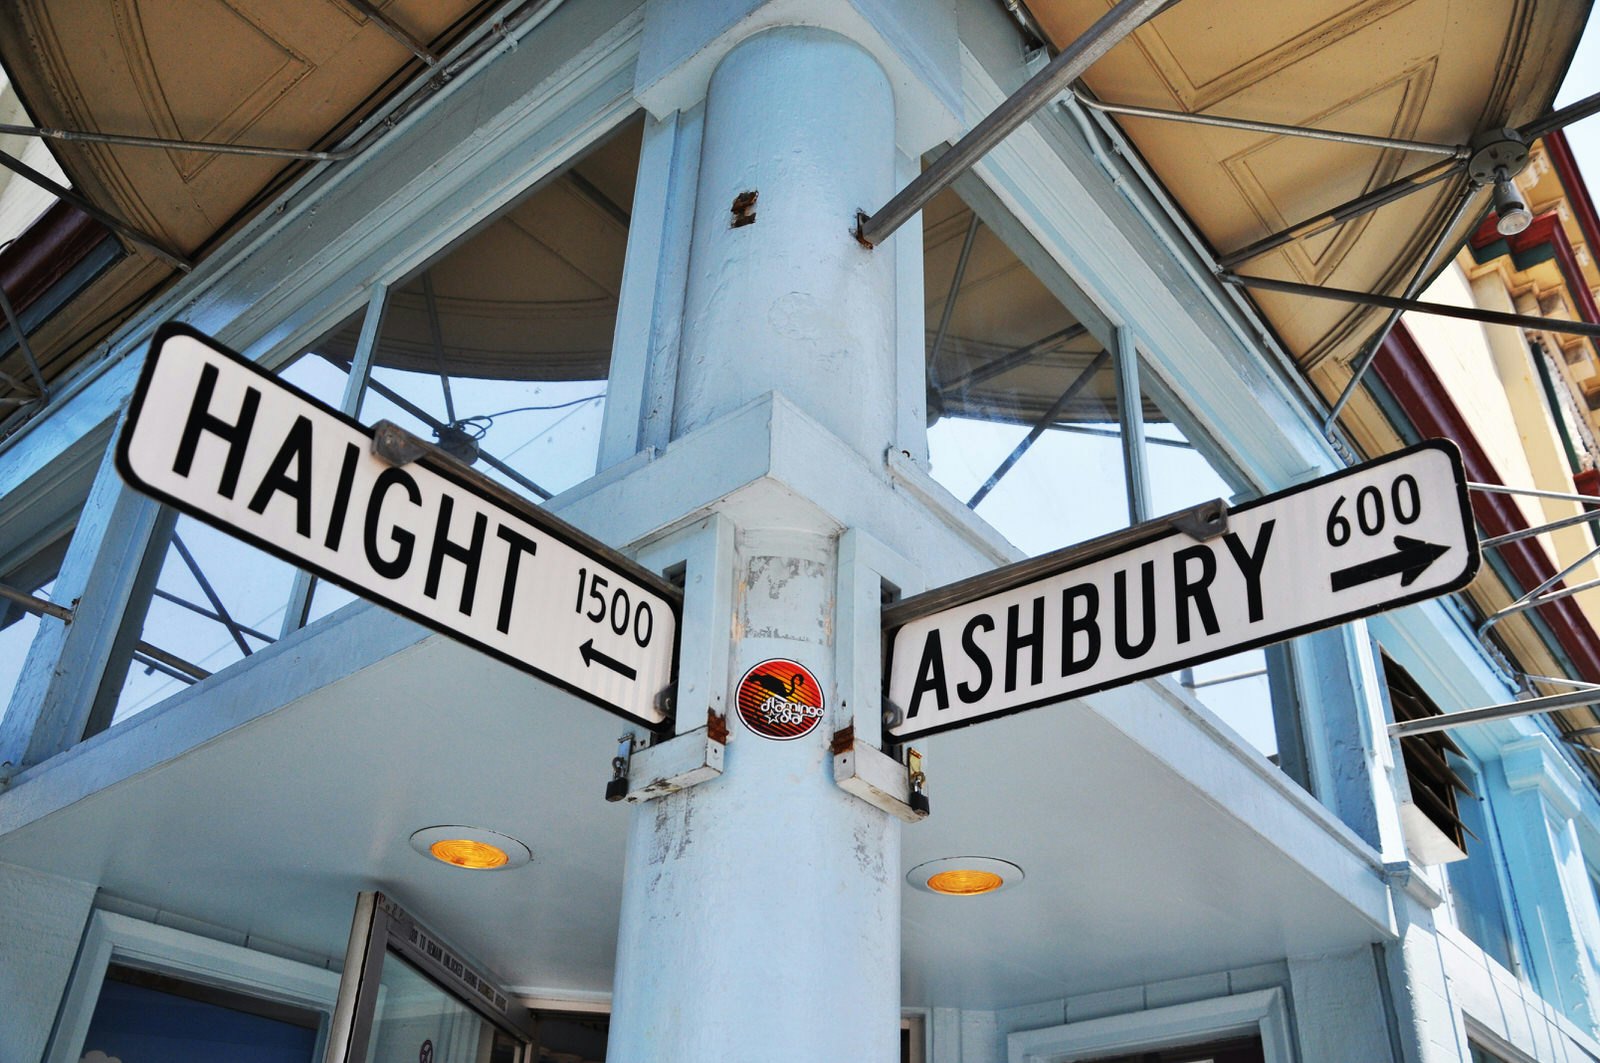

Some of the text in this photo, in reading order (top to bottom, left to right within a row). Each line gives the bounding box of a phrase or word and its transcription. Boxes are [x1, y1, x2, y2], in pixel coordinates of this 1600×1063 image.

[173, 363, 653, 648] HAIGHT 1500
[906, 474, 1421, 719] ASHBURY 600
[760, 696, 825, 718] flamingo
